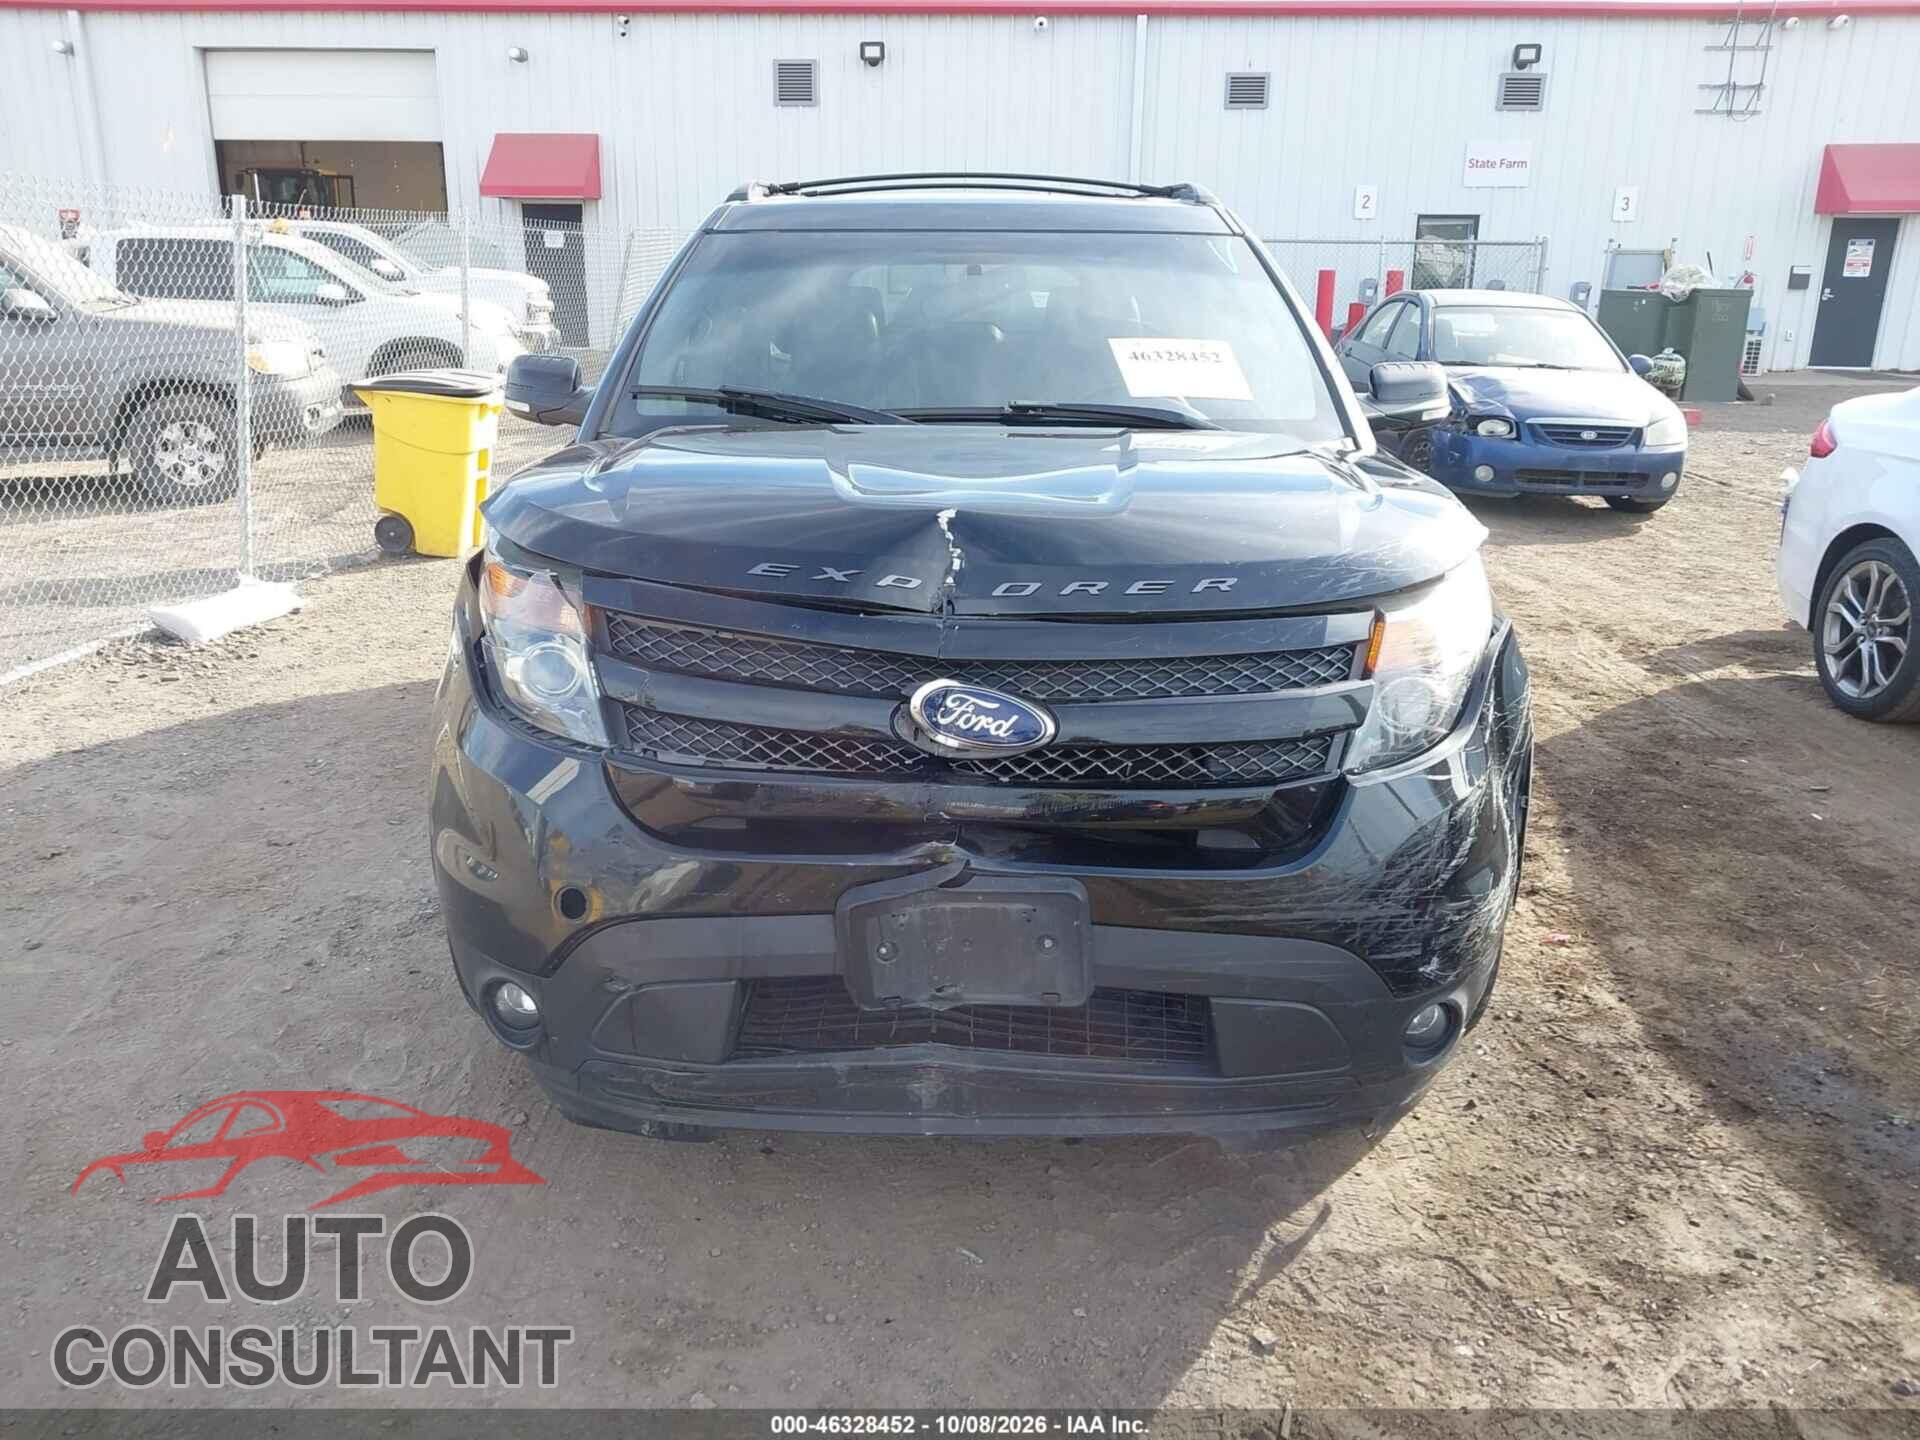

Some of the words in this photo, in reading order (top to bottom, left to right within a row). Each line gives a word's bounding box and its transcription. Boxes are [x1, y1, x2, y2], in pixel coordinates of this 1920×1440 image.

[1468, 158, 1497, 169] State
[1499, 158, 1528, 169] Farm
[1361, 194, 1371, 209] 2
[1621, 196, 1631, 212] 3
[1128, 350, 1223, 363] 46328452
[936, 692, 1025, 738] Ford
